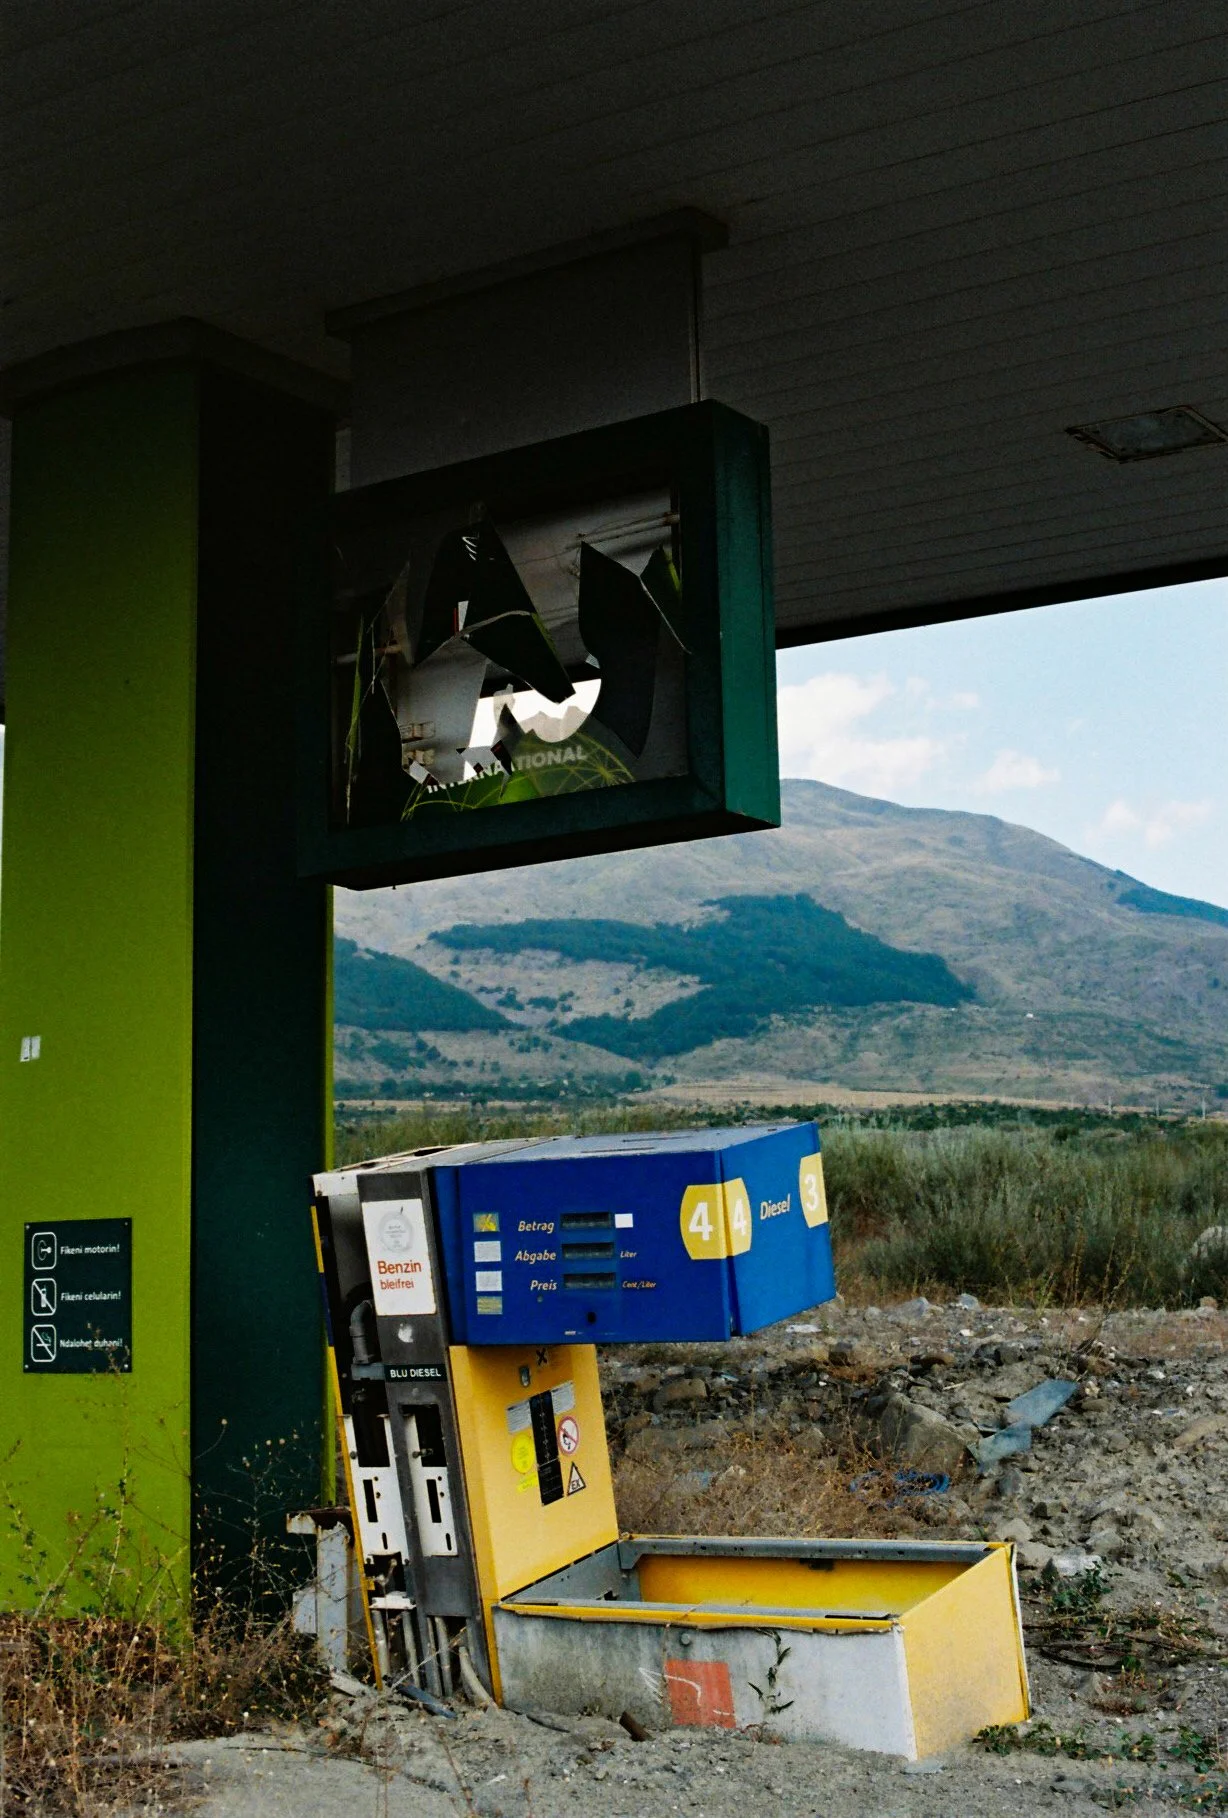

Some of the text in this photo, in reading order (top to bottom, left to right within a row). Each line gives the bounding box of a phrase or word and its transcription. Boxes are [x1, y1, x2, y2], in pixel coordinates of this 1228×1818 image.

[803, 1173, 820, 1212] 3
[760, 1193, 791, 1220] Diesel
[688, 1202, 713, 1241] 4
[733, 1199, 748, 1237] 4
[518, 1220, 555, 1234] Betrag
[60, 1245, 83, 1255] Fikeni
[515, 1249, 557, 1265] Abgabe
[377, 1259, 422, 1275] Benzin
[380, 1278, 415, 1290] bleifrei
[530, 1279, 557, 1291] Preis
[60, 1291, 83, 1301] Fikeni
[389, 1367, 441, 1379] BLU DIESEL
[571, 1479, 581, 1491] EX
